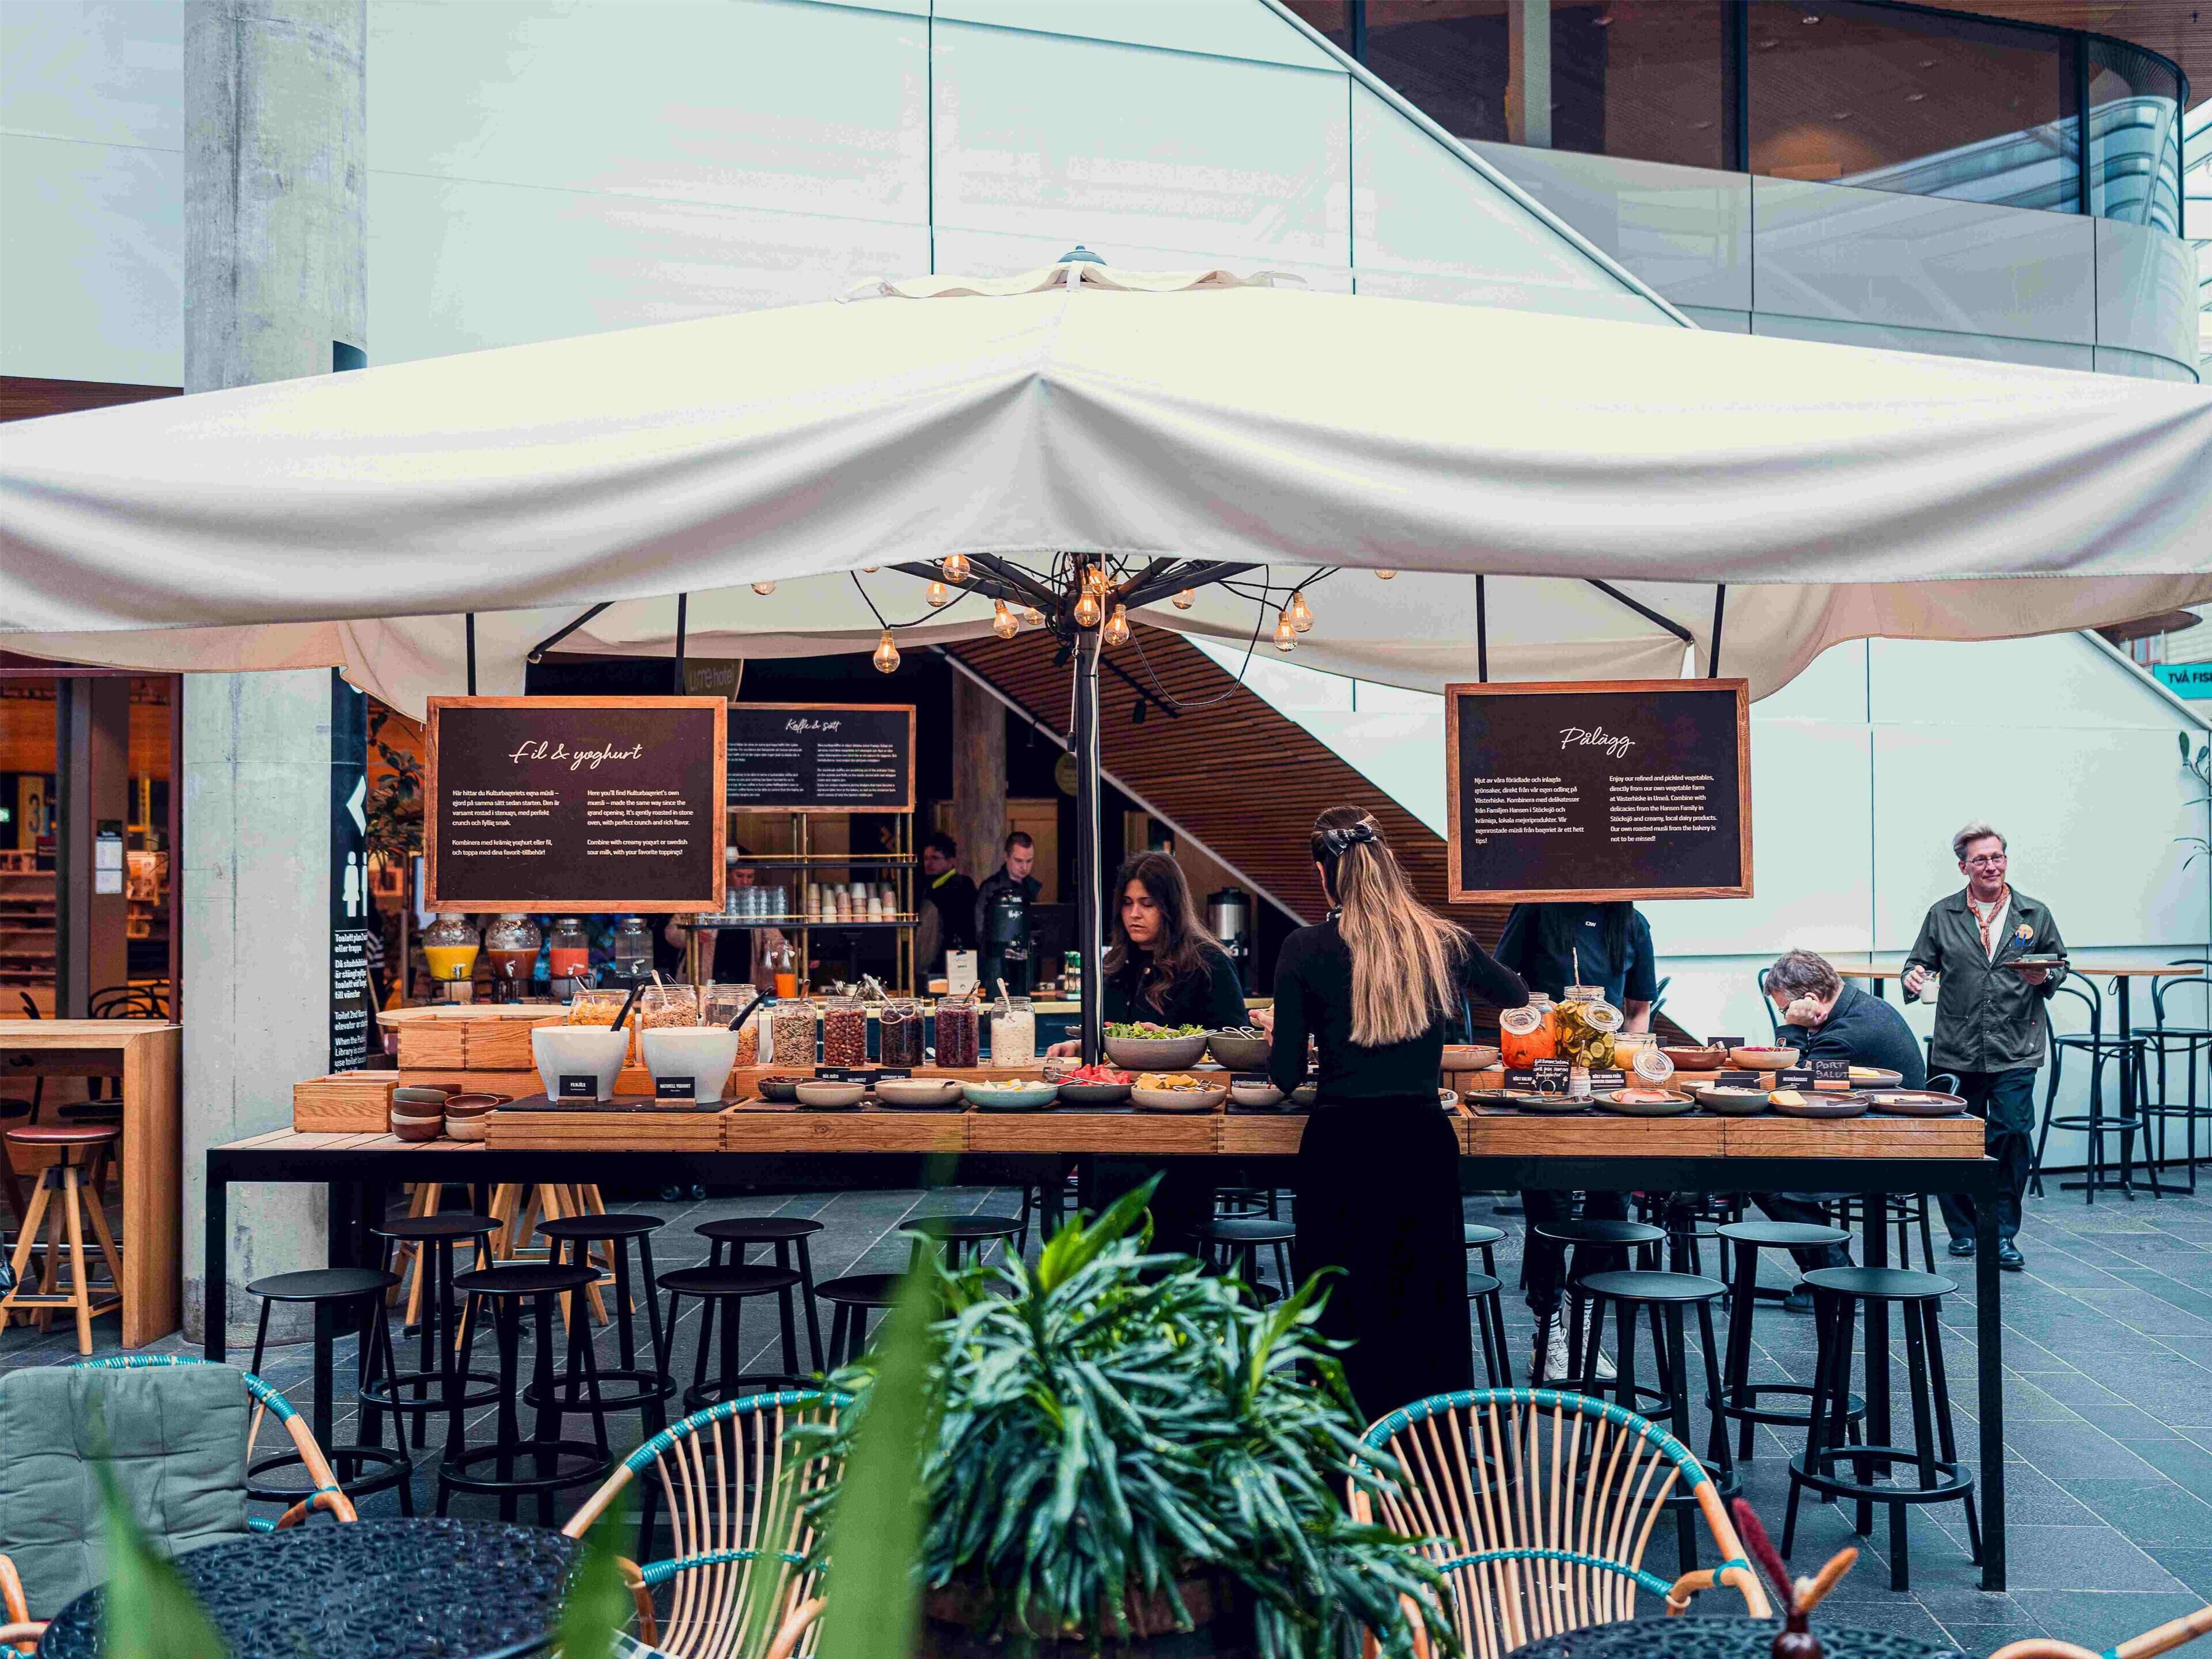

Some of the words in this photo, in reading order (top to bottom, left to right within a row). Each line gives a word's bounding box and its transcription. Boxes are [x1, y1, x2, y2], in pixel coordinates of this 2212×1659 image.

[2169, 670, 2190, 683] TVÅ
[786, 719, 812, 733] Kaffe
[1559, 726, 1635, 758] Pålägg
[509, 741, 548, 763] Fil
[551, 744, 570, 759] &
[570, 743, 642, 770] yoghurt
[28, 793, 41, 834] 3
[335, 945, 349, 953] eller
[335, 960, 343, 968] Då
[335, 970, 342, 979] är
[335, 980, 353, 988] toalett
[335, 991, 343, 999] till
[334, 1011, 350, 1020] Toilet
[335, 1021, 355, 1030] elevator
[335, 1036, 350, 1046] When
[335, 1047, 354, 1056] Library
[334, 1058, 345, 1067] use
[1816, 1060, 1845, 1069] PORT
[1816, 1070, 1849, 1079] SALUT
